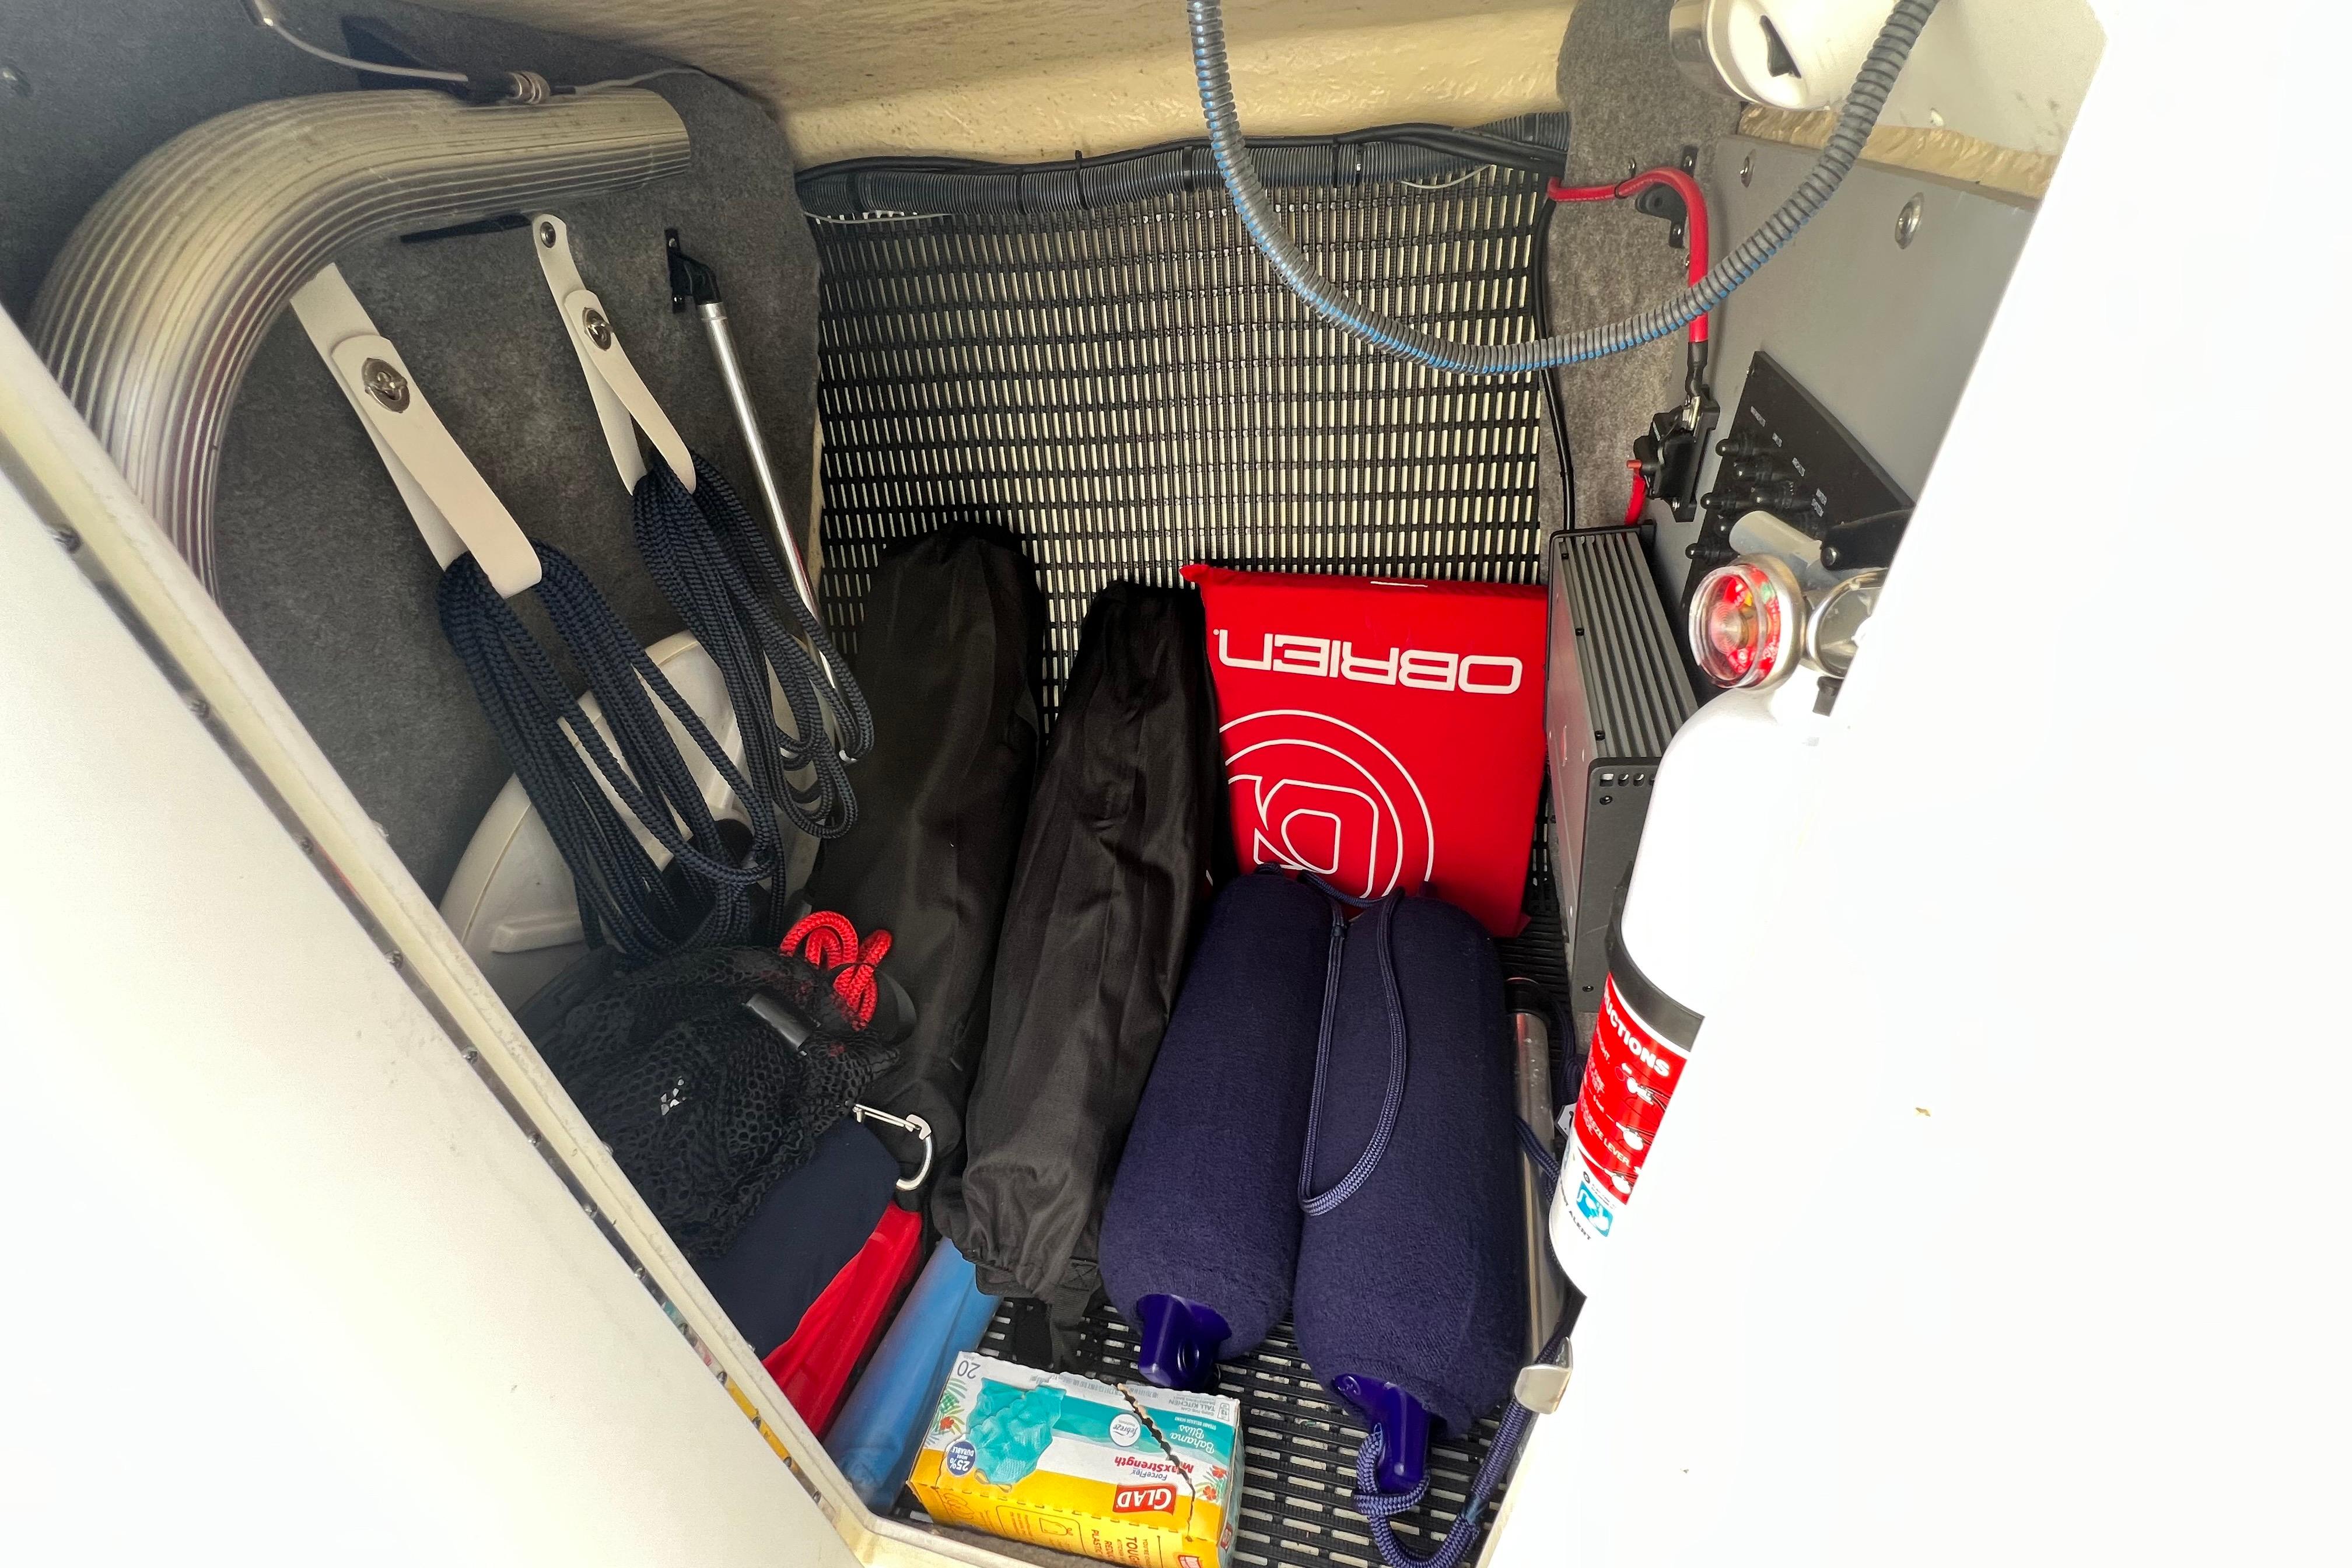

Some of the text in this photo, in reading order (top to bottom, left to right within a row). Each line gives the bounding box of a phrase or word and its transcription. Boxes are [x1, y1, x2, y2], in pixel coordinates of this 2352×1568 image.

[1219, 629, 1523, 694] OBRIEN
[957, 1360, 981, 1379] 20
[1168, 1398, 1199, 1408] KITCHEN
[1200, 1404, 1215, 1412] TALL
[1113, 1423, 1138, 1438] febreze
[1179, 1424, 1205, 1440] Bliss
[1170, 1433, 1215, 1454] Bahama
[952, 1446, 975, 1457] DURABLE
[949, 1457, 970, 1472] 25%
[1130, 1468, 1168, 1480] ForceFlex
[1116, 1488, 1172, 1510] GLAD
